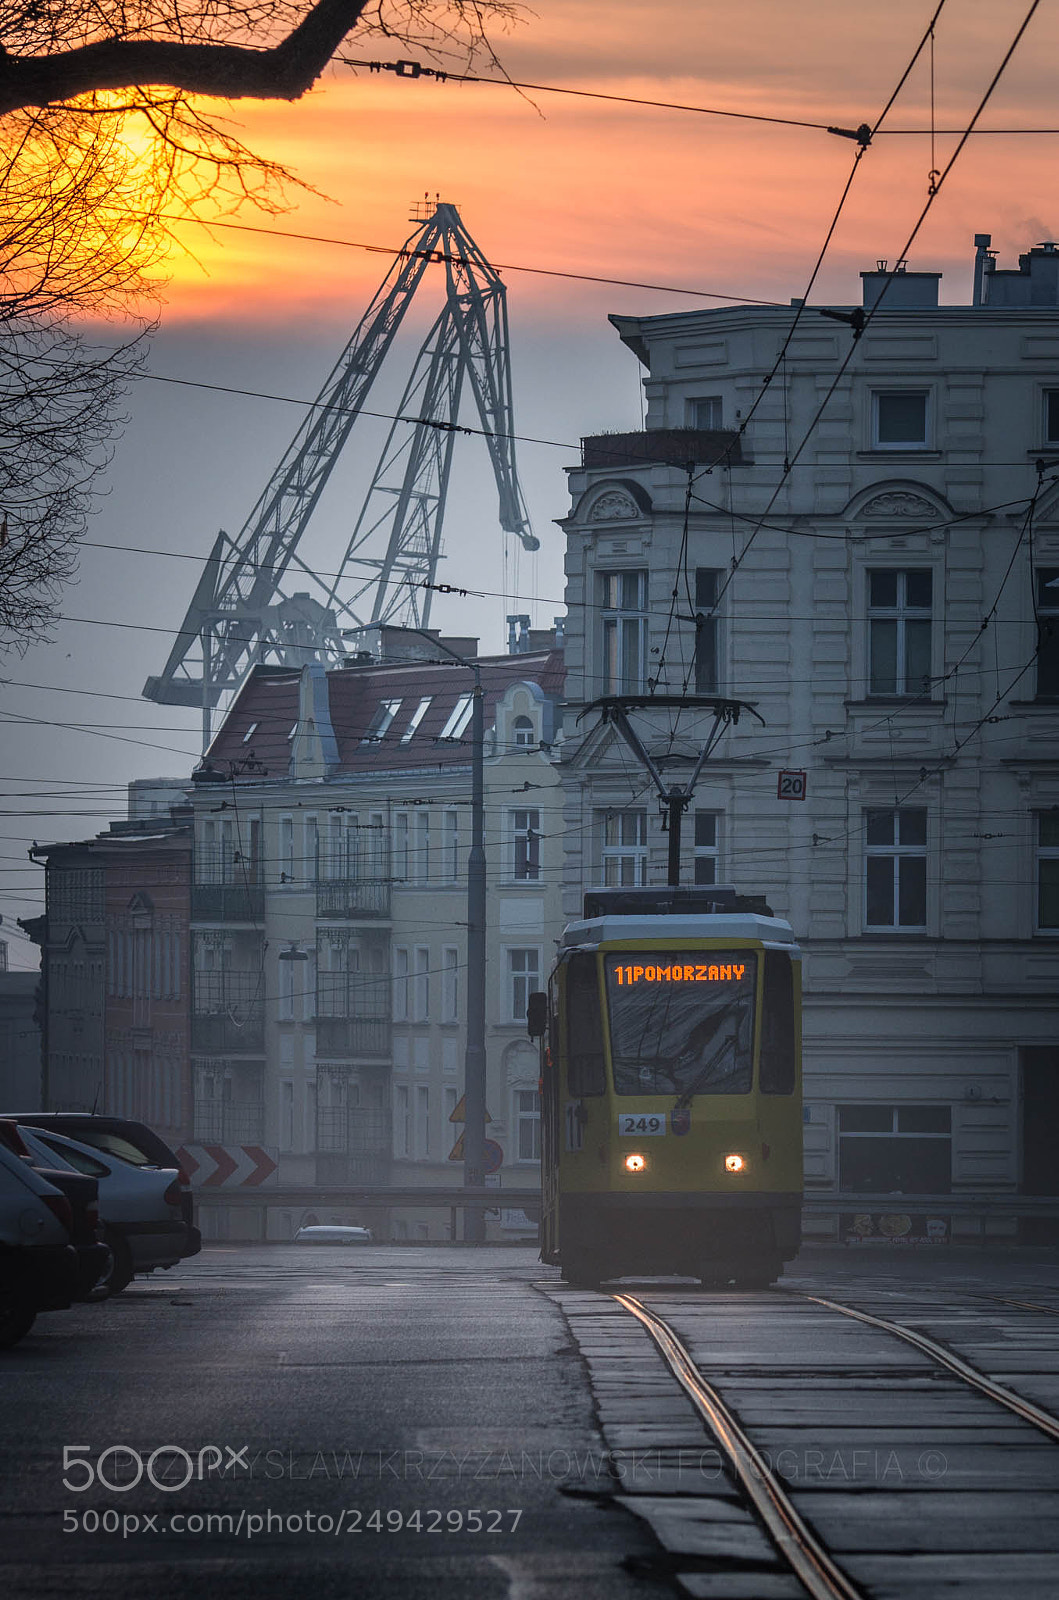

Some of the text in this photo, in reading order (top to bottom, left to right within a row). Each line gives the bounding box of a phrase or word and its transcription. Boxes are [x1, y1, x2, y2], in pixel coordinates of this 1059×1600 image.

[781, 777, 803, 794] 20
[614, 964, 746, 985] 11 POMORZANY
[624, 1117, 661, 1133] 249
